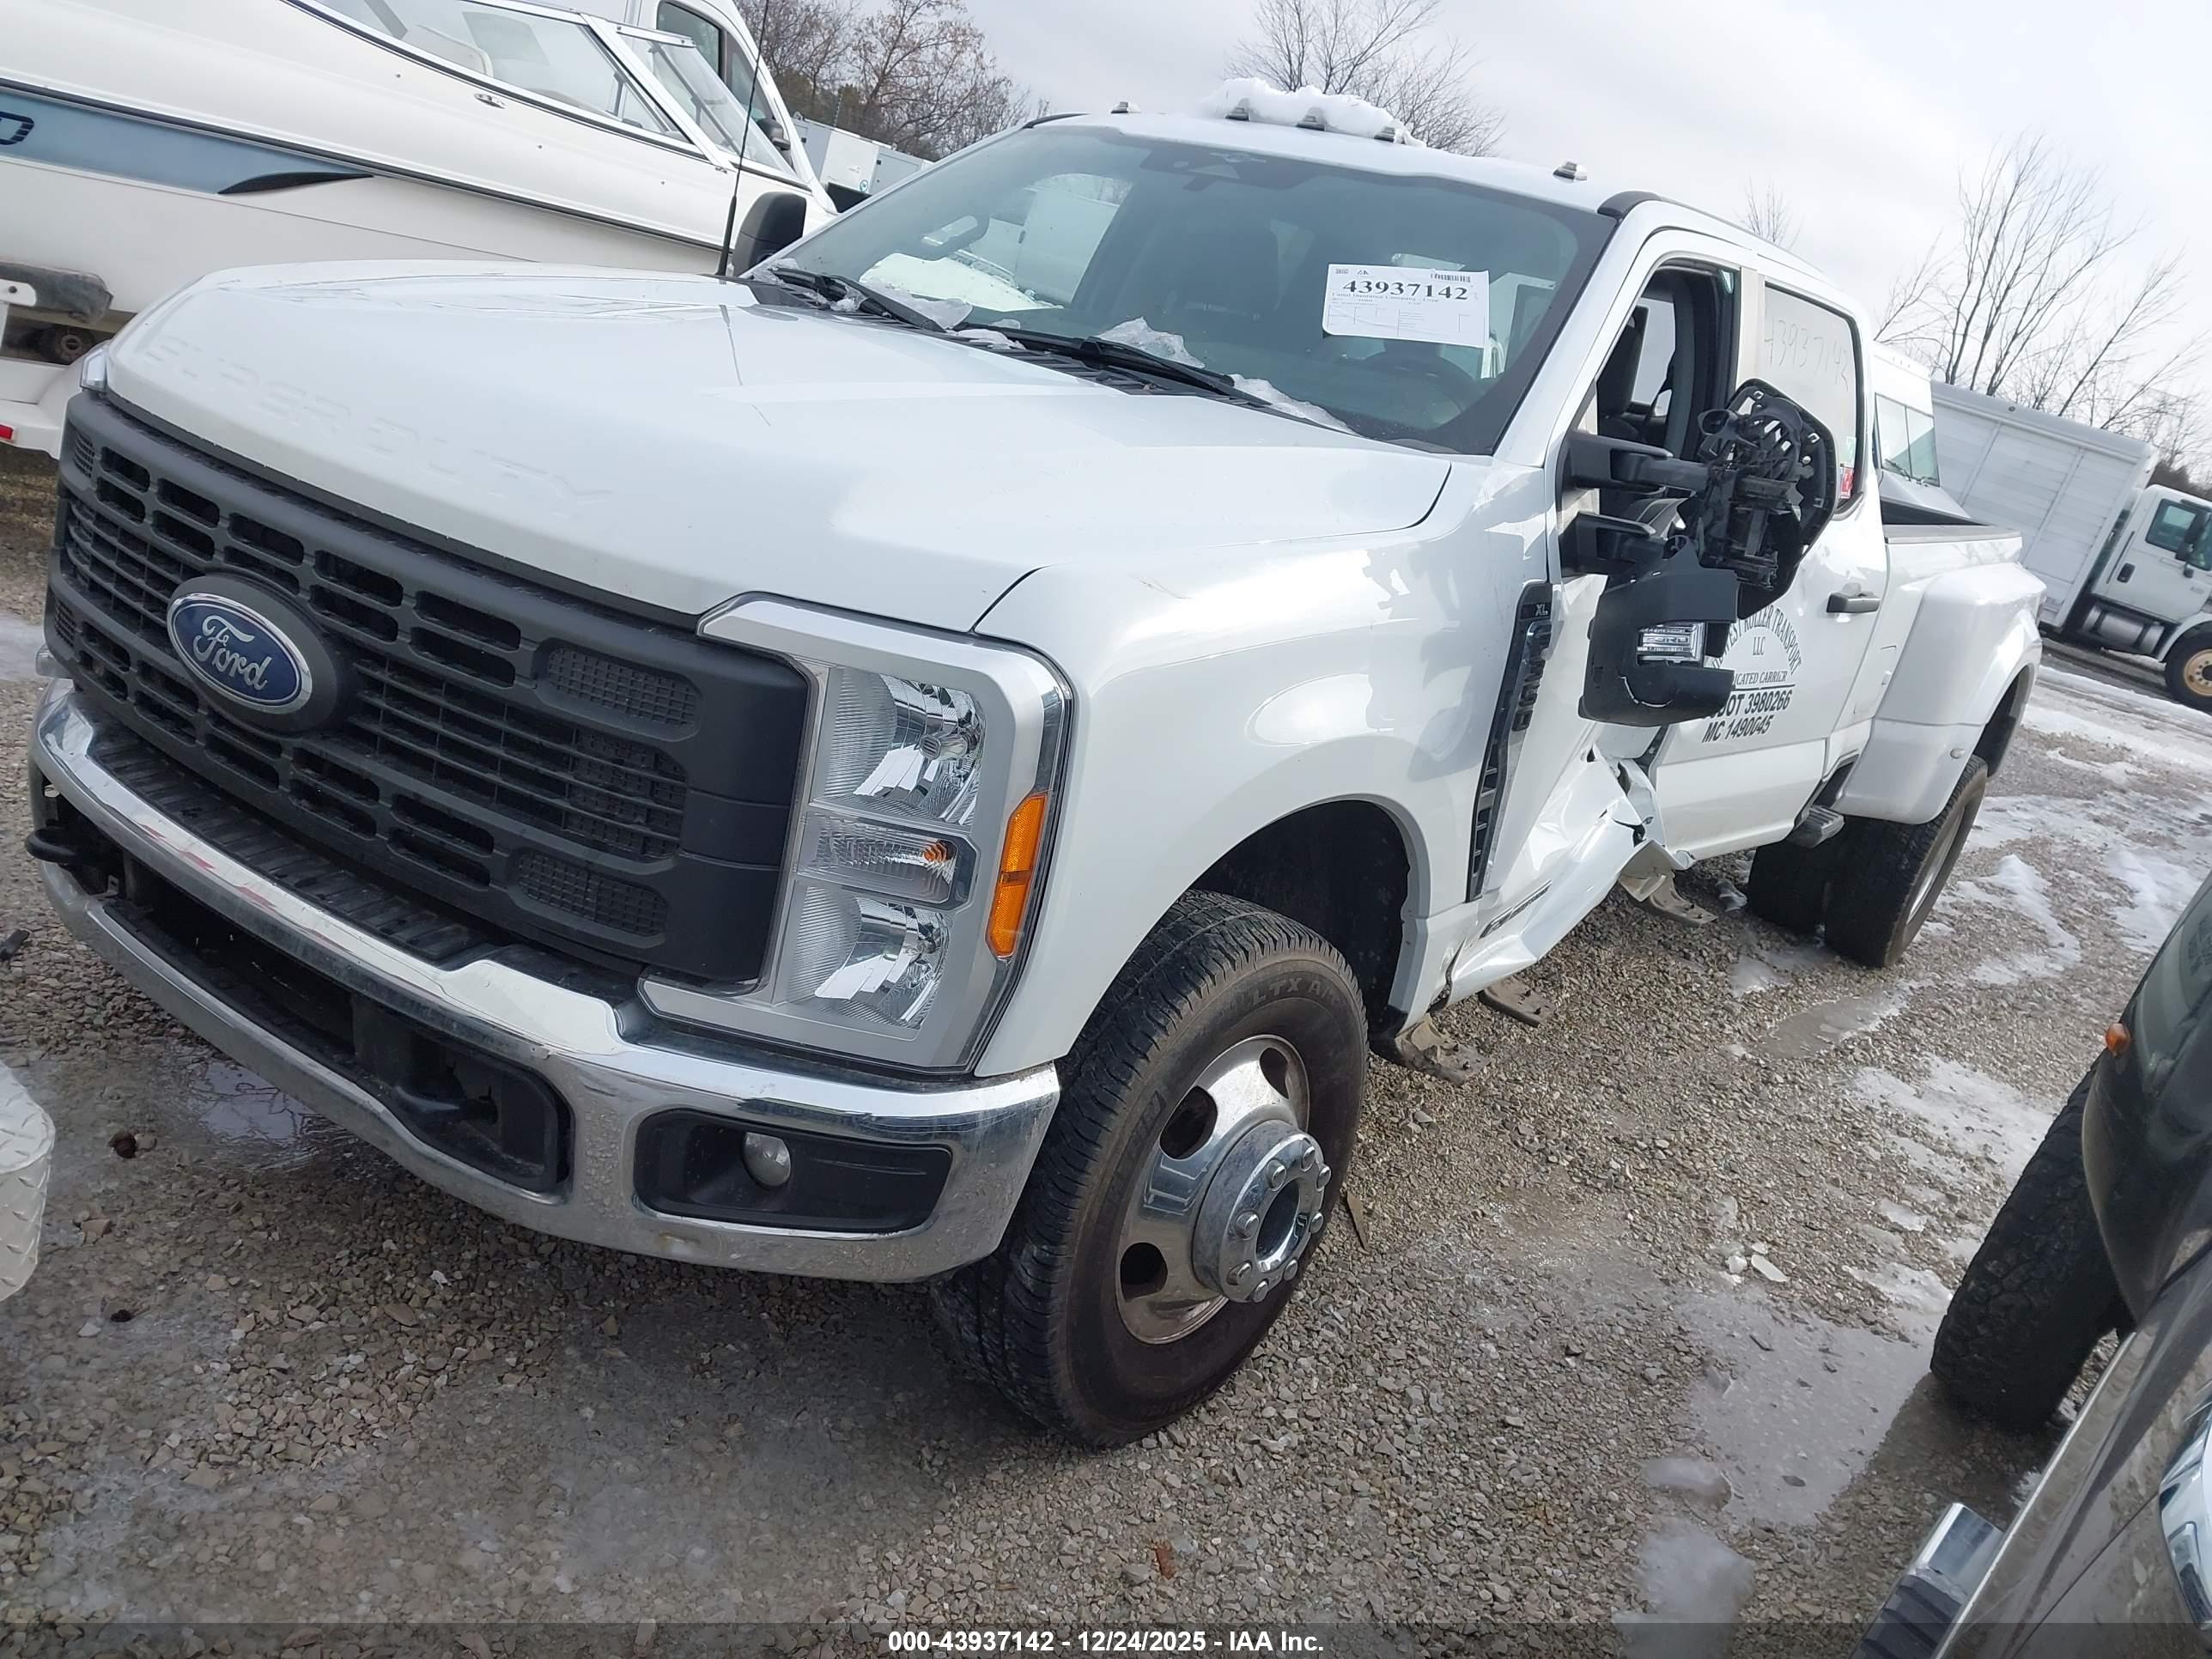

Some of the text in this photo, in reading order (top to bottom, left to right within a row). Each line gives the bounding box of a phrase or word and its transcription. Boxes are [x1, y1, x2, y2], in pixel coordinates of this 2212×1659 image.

[1343, 280, 1468, 301] 43937142
[192, 615, 273, 690] Ford
[1753, 636, 1765, 655] LLC
[1771, 608, 1802, 676] TRANSPORT
[1731, 671, 1788, 685] ICATED CARRIER
[1744, 690, 1792, 714] 3980266
[1701, 720, 1726, 743] MC
